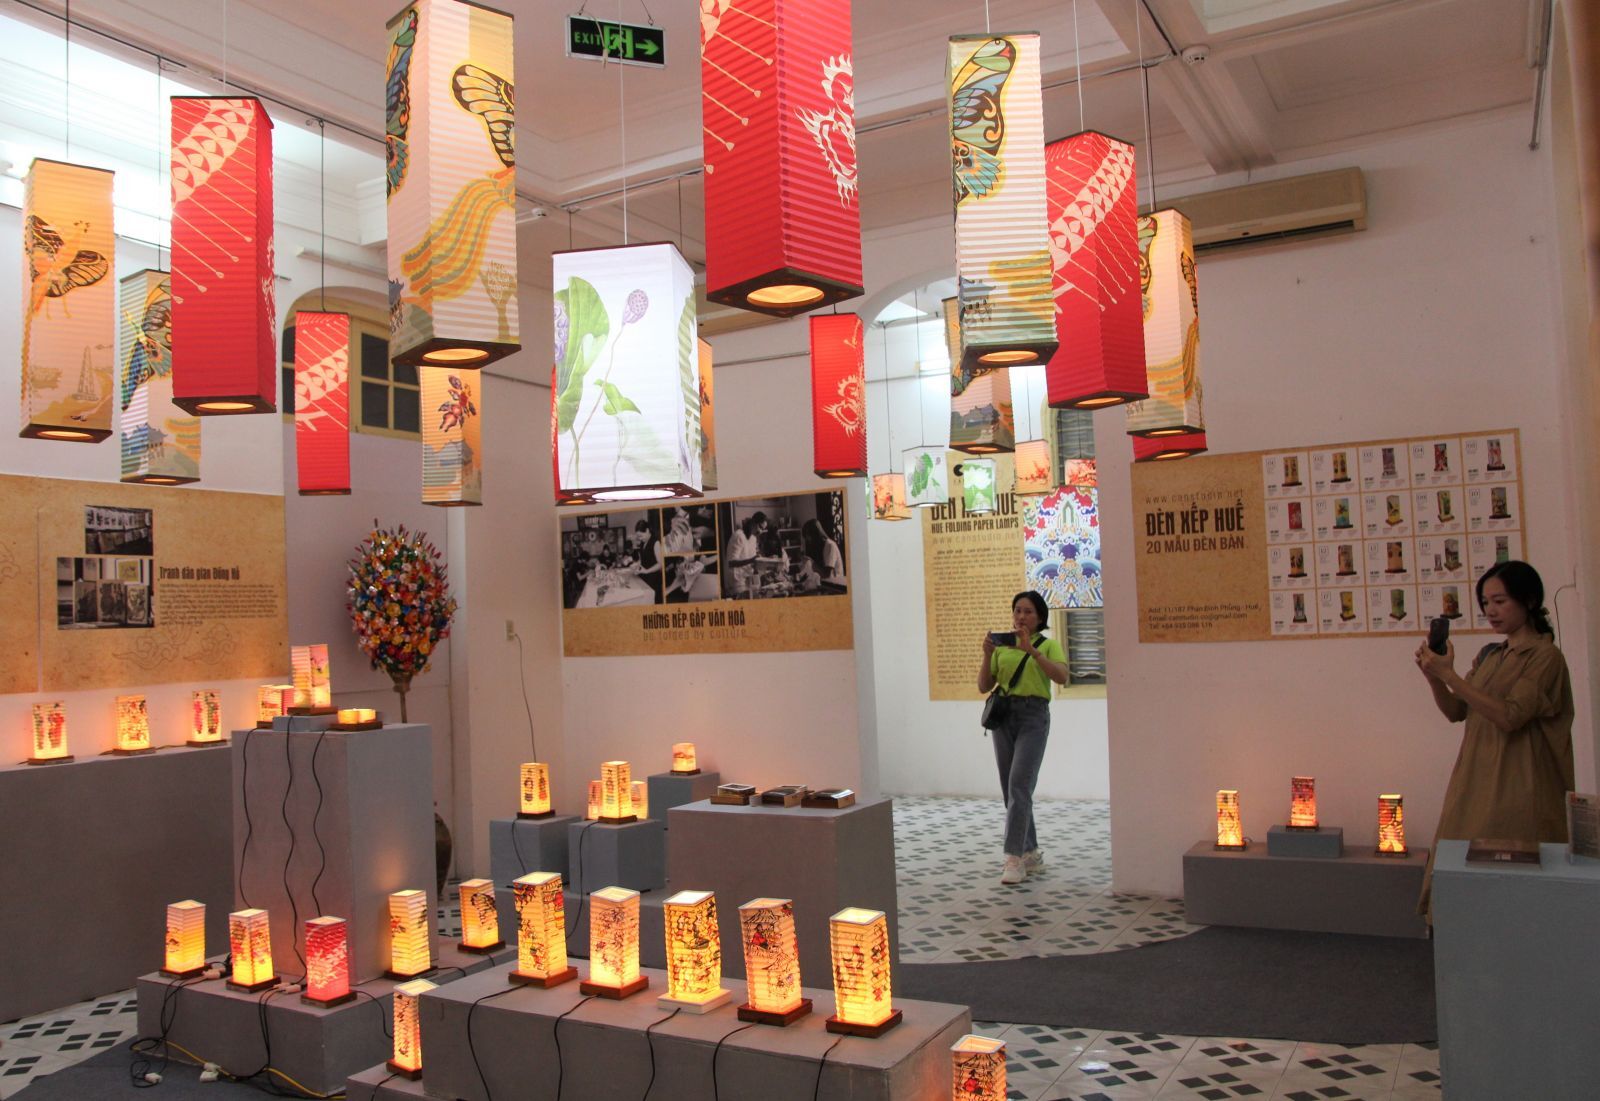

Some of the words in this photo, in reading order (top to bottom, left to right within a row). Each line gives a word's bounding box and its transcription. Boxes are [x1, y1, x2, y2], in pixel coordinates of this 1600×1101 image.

[574, 31, 601, 46] EXIT
[931, 522, 943, 534] HUE
[945, 521, 972, 533] FOLDING
[973, 519, 994, 531] PAPER
[996, 517, 1019, 530] LAMPS
[1145, 508, 1175, 536] ĐÈN
[1181, 501, 1208, 534] XẾP
[1215, 498, 1245, 532] HUẾ
[1146, 541, 1161, 554] 20
[1164, 535, 1190, 552] MẪU
[1193, 535, 1216, 551] ĐÈN
[1220, 534, 1244, 550] BÀN
[160, 566, 180, 579] Tranh
[182, 566, 194, 579] dân
[196, 566, 211, 581] gian
[643, 611, 669, 629] NHỮNG
[672, 608, 687, 628] NẾP
[690, 607, 705, 628] GẤP
[708, 608, 725, 627] VĂN
